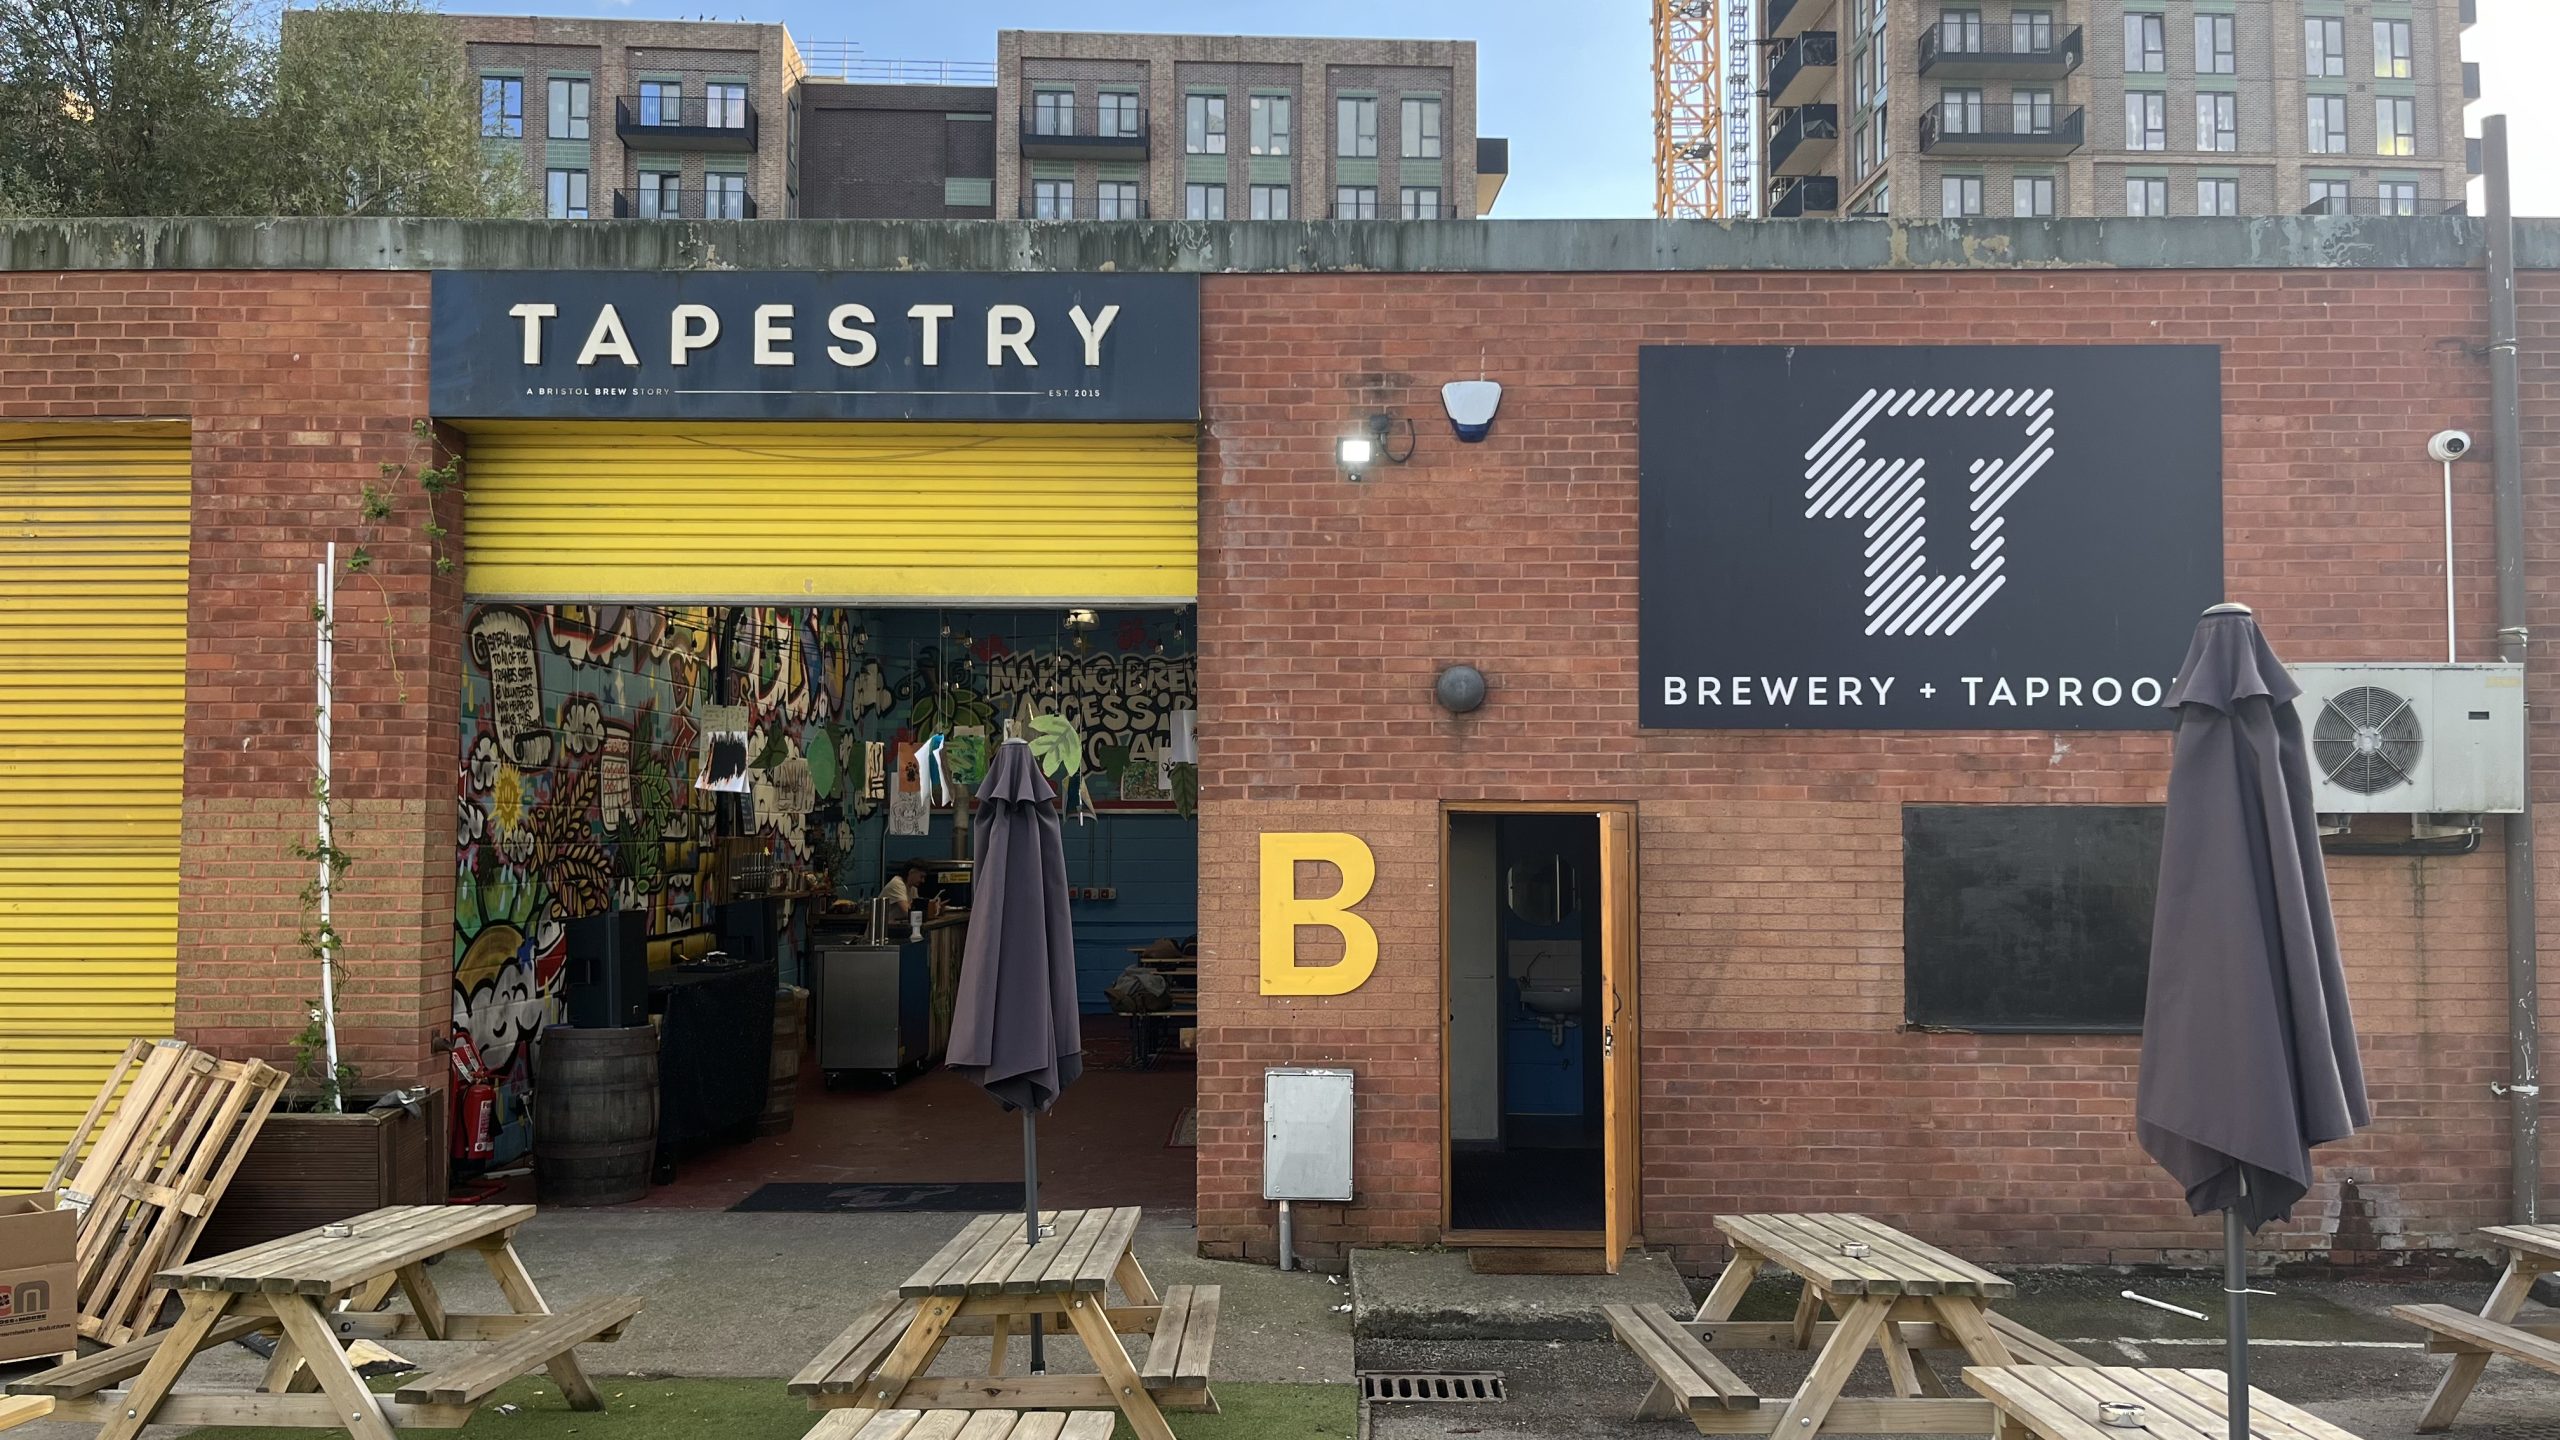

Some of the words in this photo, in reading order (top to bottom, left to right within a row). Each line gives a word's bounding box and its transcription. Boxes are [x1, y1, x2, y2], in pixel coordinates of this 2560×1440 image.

[508, 302, 1120, 367] TAPESTRY
[526, 387, 534, 396] A
[538, 387, 590, 396] BRISTOL
[594, 387, 627, 396] BREW
[632, 387, 670, 396] STORY
[1048, 389, 1069, 398] EST
[1074, 389, 1101, 398] 2015
[492, 653, 501, 665] TO
[508, 652, 516, 665] OF
[516, 651, 529, 665] THE
[1664, 676, 1896, 706] BREWERY
[1919, 682, 1937, 699] +
[1961, 676, 2178, 707] TAPROO
[1258, 832, 1381, 996] B
